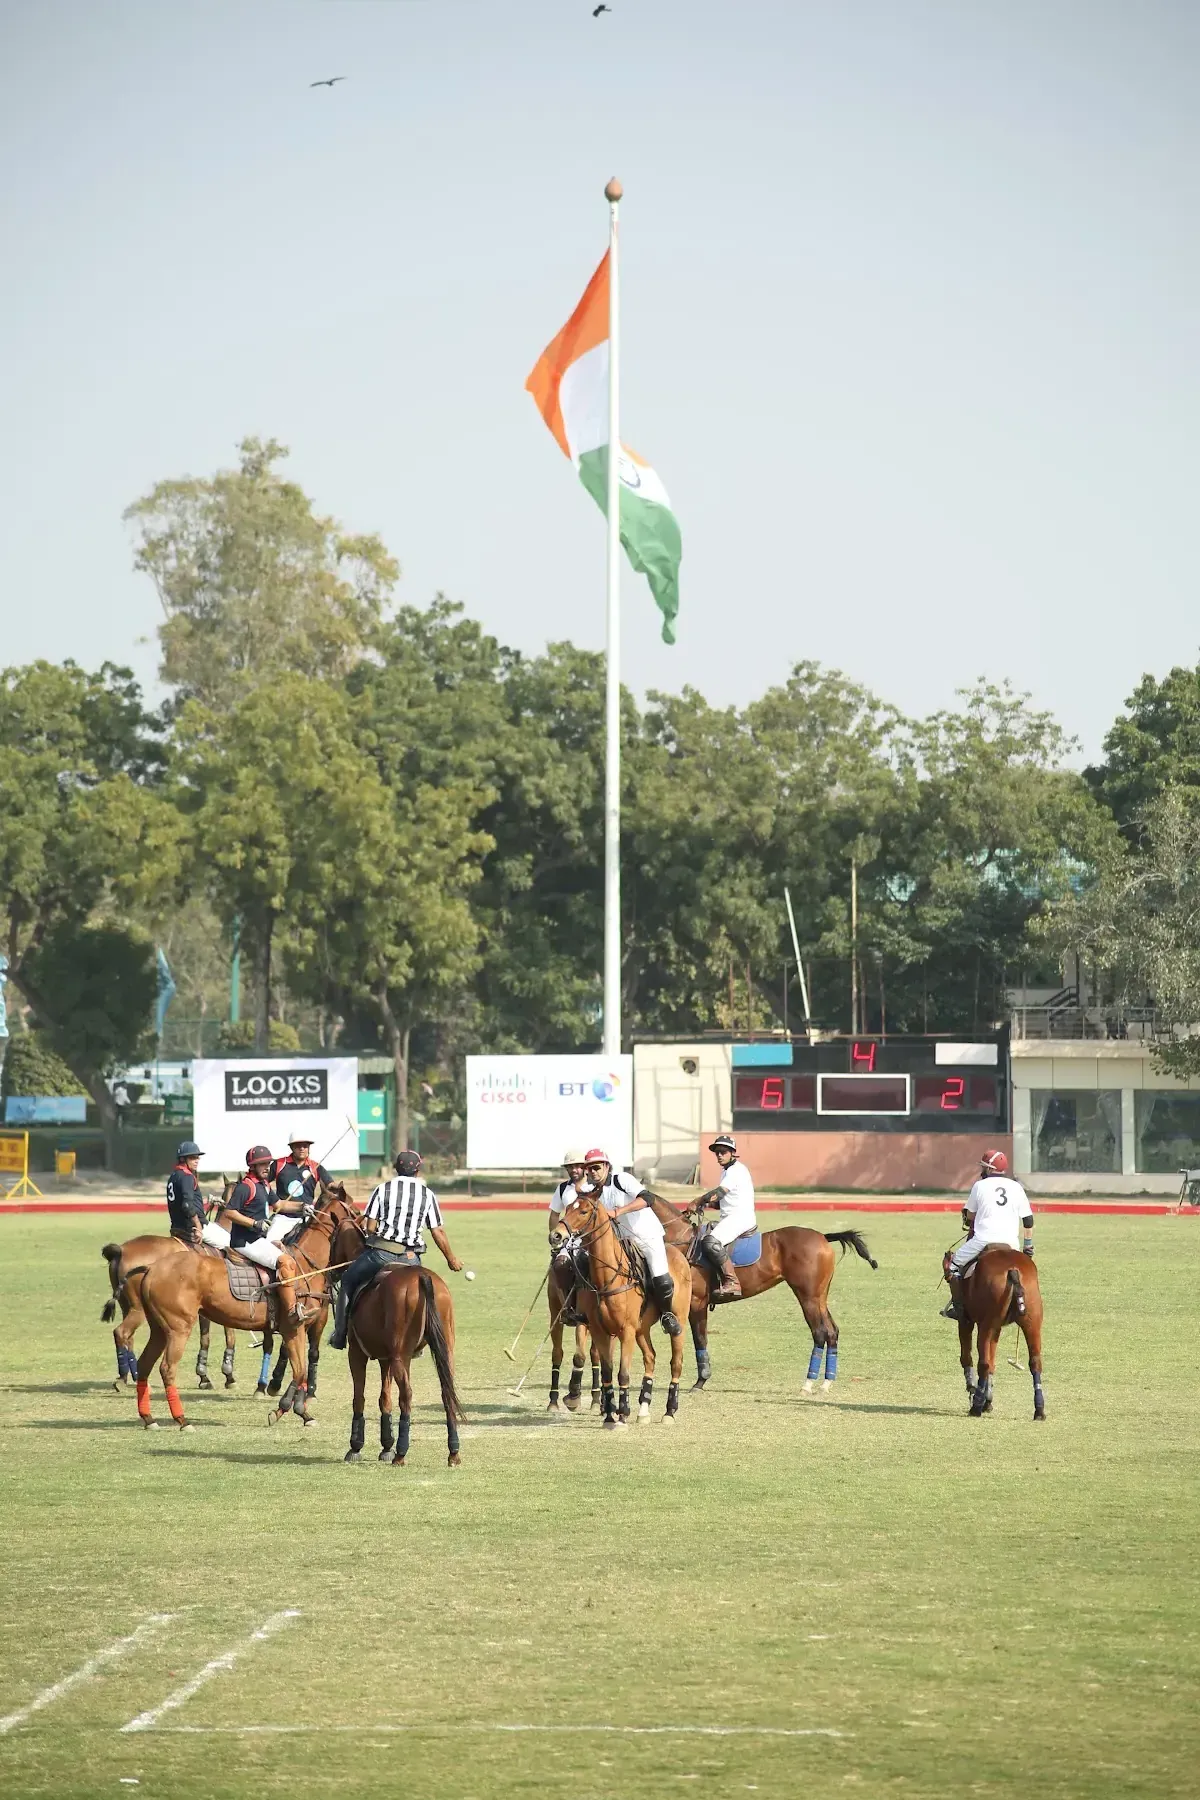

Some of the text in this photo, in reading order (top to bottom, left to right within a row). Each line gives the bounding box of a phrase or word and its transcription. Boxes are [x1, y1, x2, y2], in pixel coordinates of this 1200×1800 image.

[853, 1042, 876, 1072] 4
[231, 1075, 321, 1095] LOOKS
[559, 1082, 589, 1096] BT
[761, 1078, 783, 1109] 6
[940, 1078, 964, 1109] 2
[232, 1096, 321, 1106] UNISEX SALON
[480, 1092, 527, 1104] CISCO
[167, 1181, 176, 1202] 3
[994, 1186, 1008, 1207] 3
